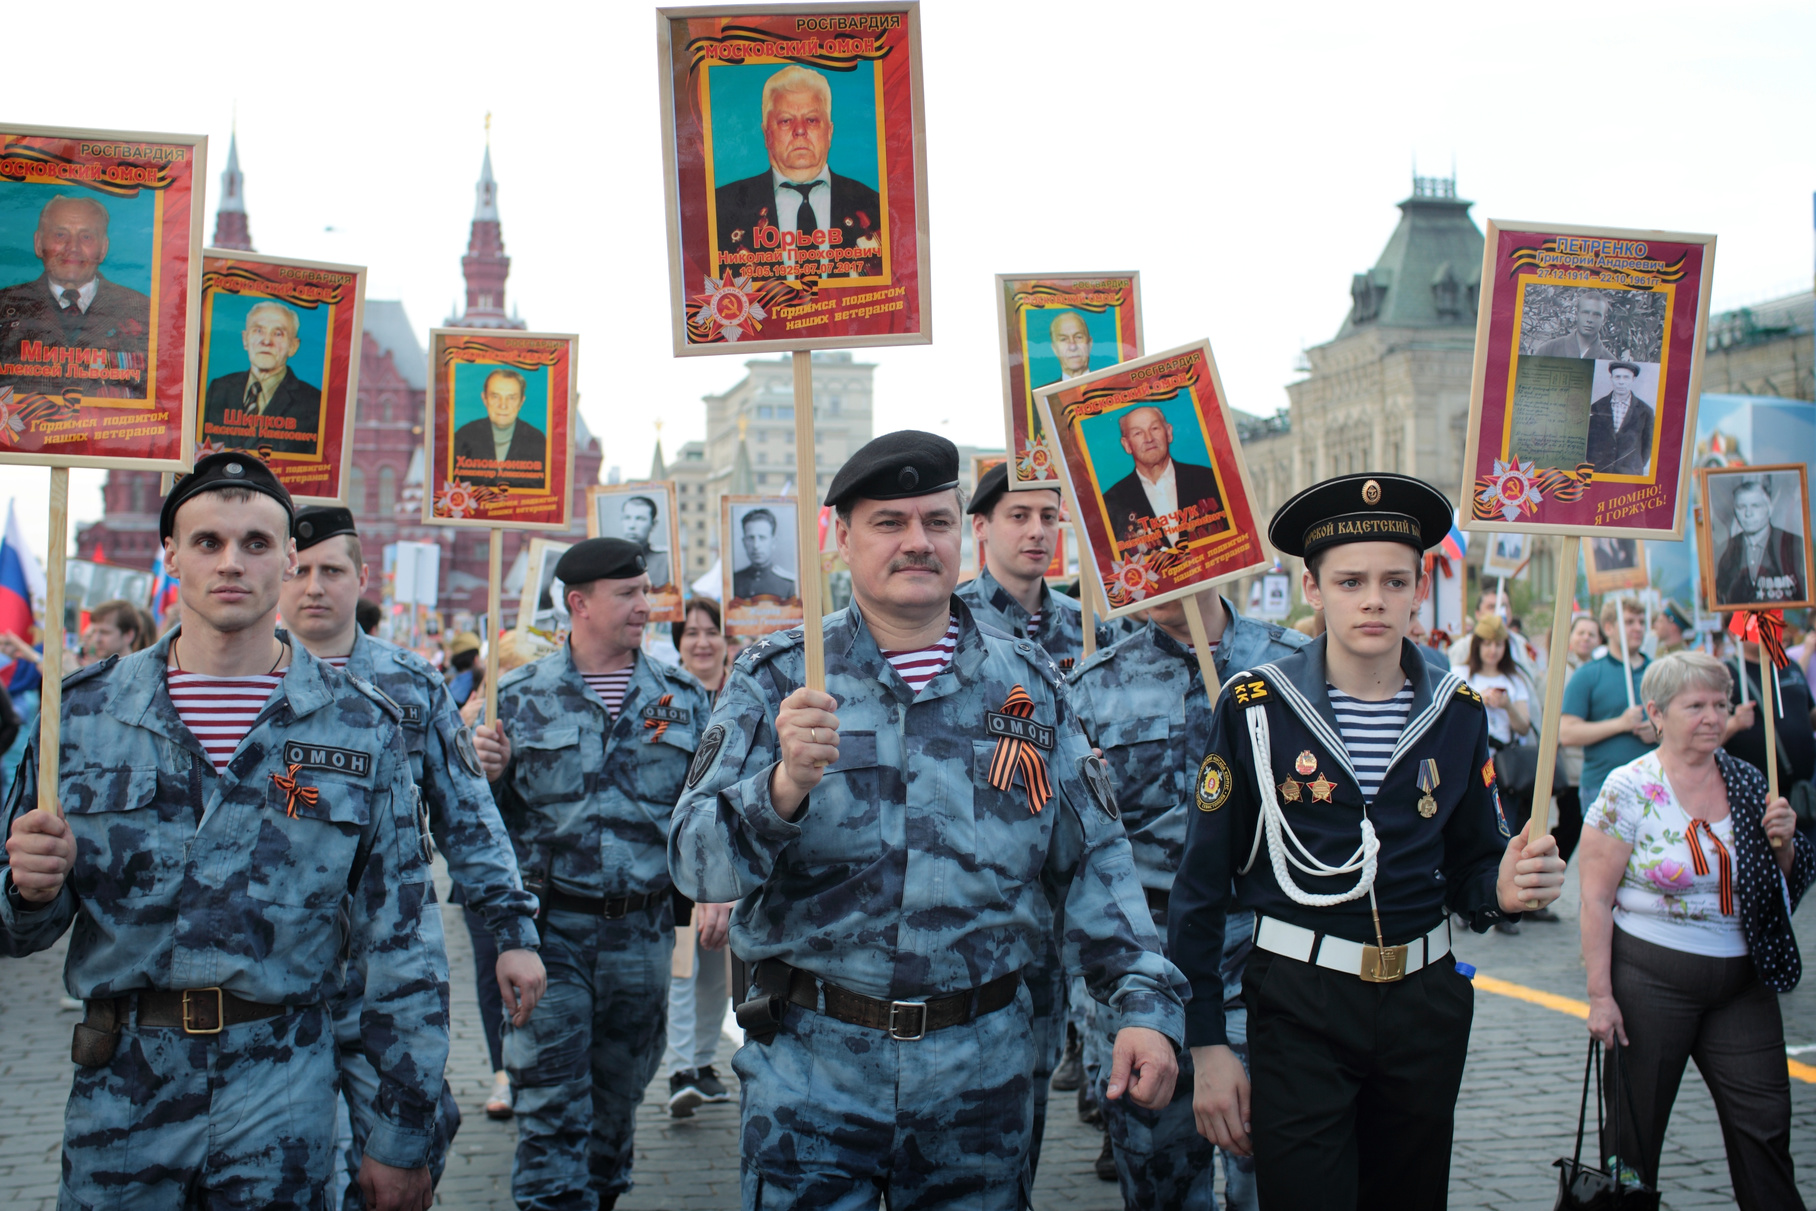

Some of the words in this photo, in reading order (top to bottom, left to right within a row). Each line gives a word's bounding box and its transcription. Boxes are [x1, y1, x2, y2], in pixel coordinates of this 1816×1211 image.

[796, 15, 900, 32] РОСГВАРДИЯ
[705, 37, 820, 59] МОСКОВСКИЙ
[824, 39, 875, 55] ОМОН
[81, 143, 186, 161] РОСГВАРДИЯ
[0, 160, 102, 181] ОСКОВСКИЙ
[107, 166, 159, 183] ОМОН
[752, 225, 843, 252] Юрьев
[1556, 237, 1648, 258] ПЕТРЕНКО
[717, 248, 783, 265] Николай
[787, 246, 882, 263] Прохорович
[1536, 250, 1594, 268] Григорий
[1596, 256, 1666, 271] Андреевич
[279, 268, 352, 284] РОСГВАРДИЯ
[739, 261, 865, 278] 19.05.1925-07.07.2017
[1537, 269, 1590, 281] 27.12.1914
[212, 276, 294, 295] МОСКОВСКИЙ
[296, 286, 333, 299] ОМОН
[1073, 280, 1130, 289] РОСГВАРДИЯ
[771, 299, 837, 320] Гордимся
[842, 286, 906, 307] подвигом
[1022, 291, 1087, 306] МОСКОВСКИЙ
[785, 314, 829, 331] наших
[834, 300, 904, 322] ветеранов
[20, 340, 108, 365] Минин
[66, 364, 141, 381] Львович
[1130, 353, 1200, 382] РОСГВАРДИЯ
[1074, 382, 1151, 417] МОСКОВСКИЙ
[1153, 373, 1188, 392] ОМОН
[30, 416, 97, 433] Гордимся
[103, 411, 169, 427] подвигом
[224, 408, 297, 430] Шипков
[43, 431, 88, 445] наших
[93, 425, 166, 441] ветеранов
[204, 422, 256, 437] Василий
[258, 426, 317, 442] Иванович
[1597, 501, 1605, 513] Я
[1608, 483, 1662, 510] ПОМНЮ!
[1136, 504, 1200, 533] Ткачук
[1594, 514, 1603, 526] Я
[1606, 494, 1667, 523] ГОРЖУСЬ!
[1163, 510, 1227, 536] Николаевич
[1337, 520, 1410, 535] КАДЕТСКИЙ
[646, 707, 687, 720] ОМОН
[992, 717, 1050, 745] ОМОН
[290, 747, 364, 771] ОМОН
